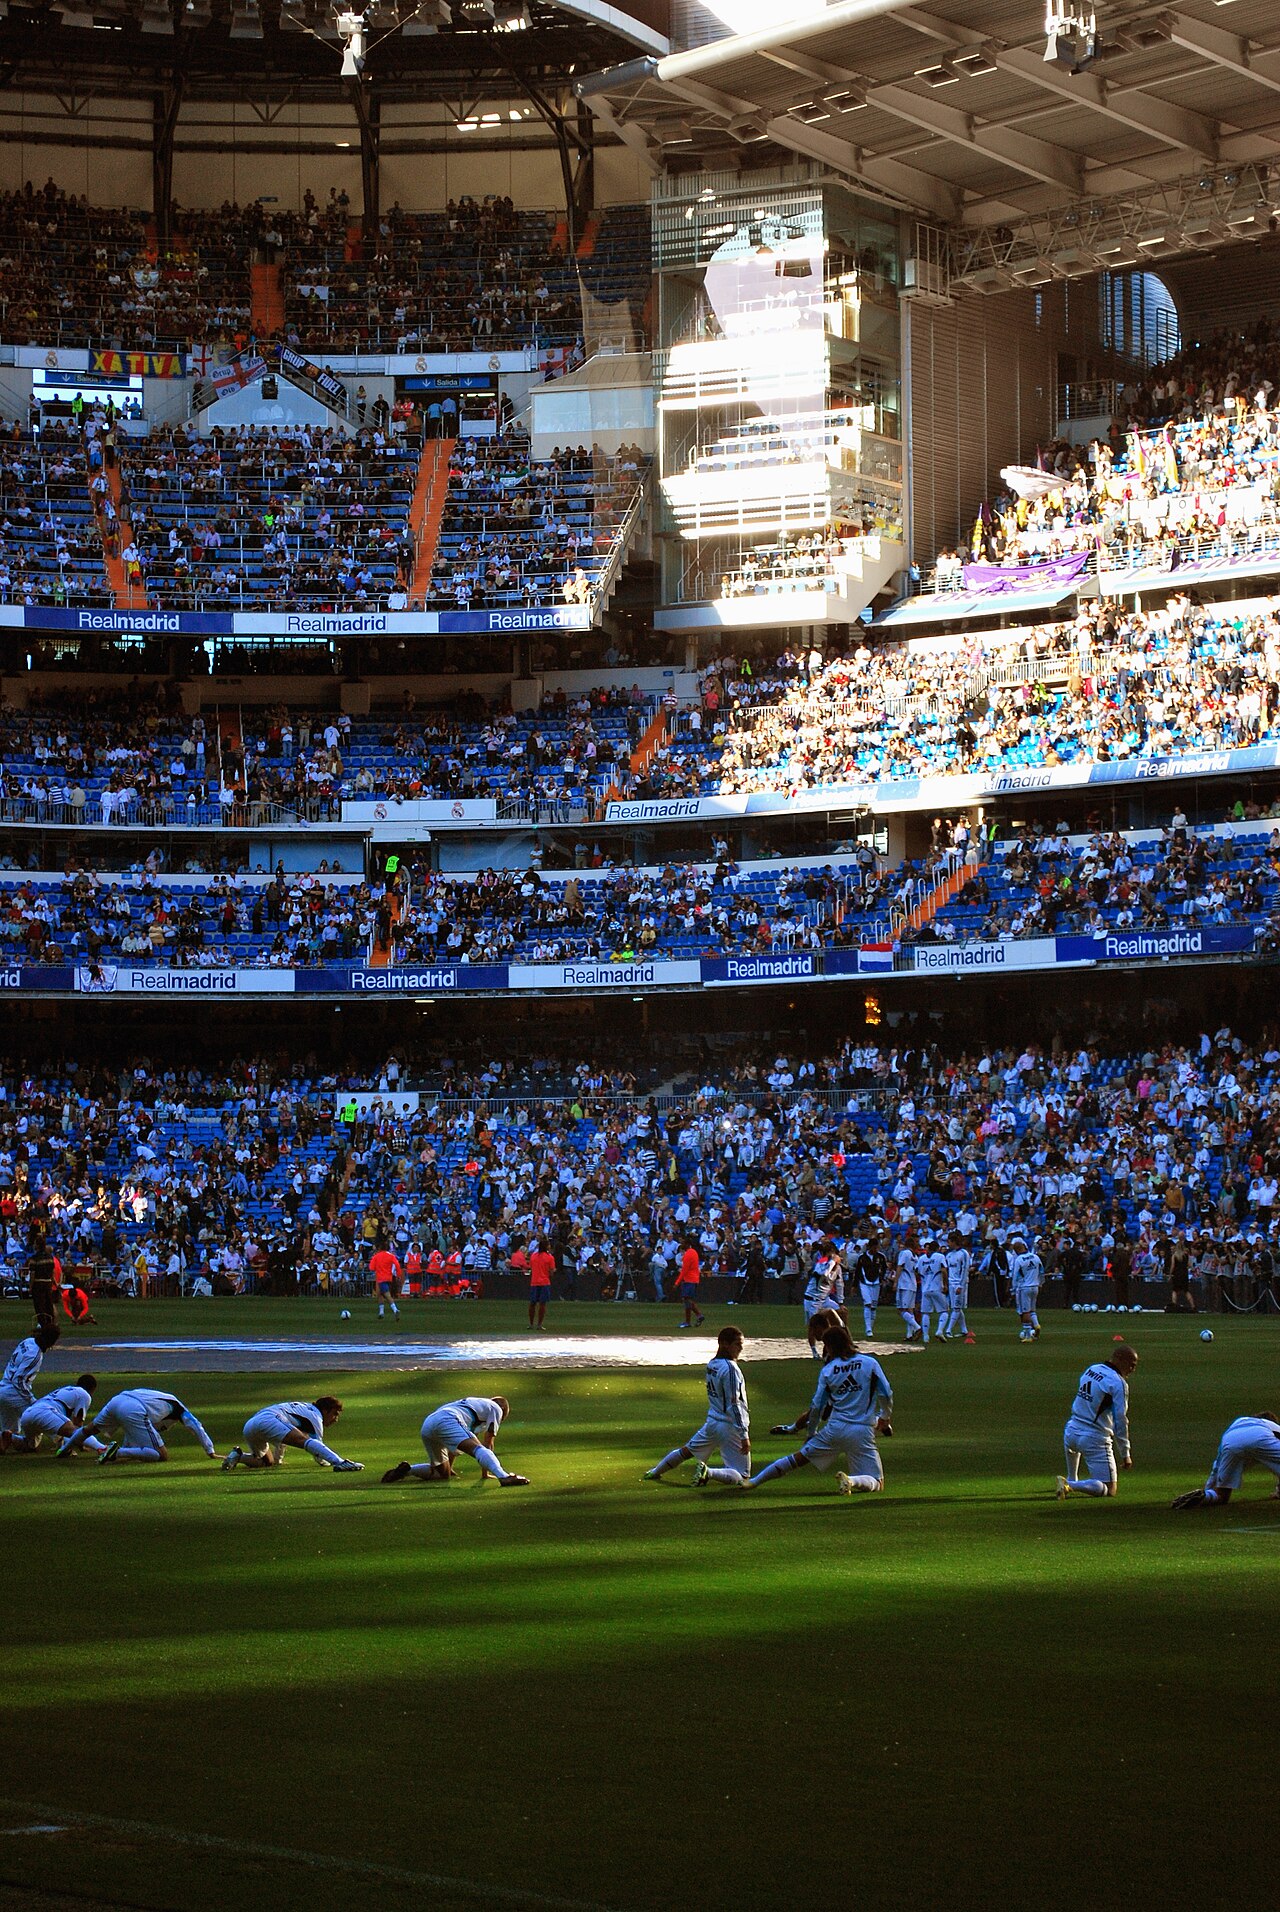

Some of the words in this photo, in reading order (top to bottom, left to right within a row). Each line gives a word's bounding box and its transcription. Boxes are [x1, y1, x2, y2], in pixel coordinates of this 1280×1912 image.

[92, 351, 182, 375] XATIVA
[282, 347, 306, 369] GRUP
[316, 373, 341, 396] FIDEL
[436, 378, 458, 387] Salida
[79, 611, 180, 631] Realmadrid
[287, 615, 386, 632] Realmadrid
[489, 610, 586, 629] Realmadrid
[1135, 753, 1230, 777] Realmadrid
[608, 801, 699, 819] Realmadrid
[1106, 932, 1202, 956] Realmadrid
[916, 945, 1005, 968] Realmadrid
[563, 965, 654, 984] Realmadrid
[727, 955, 812, 978] Realmadrid
[131, 972, 236, 989] Realmadrid
[351, 970, 455, 989] Realmadrid
[833, 1361, 862, 1375] bwin
